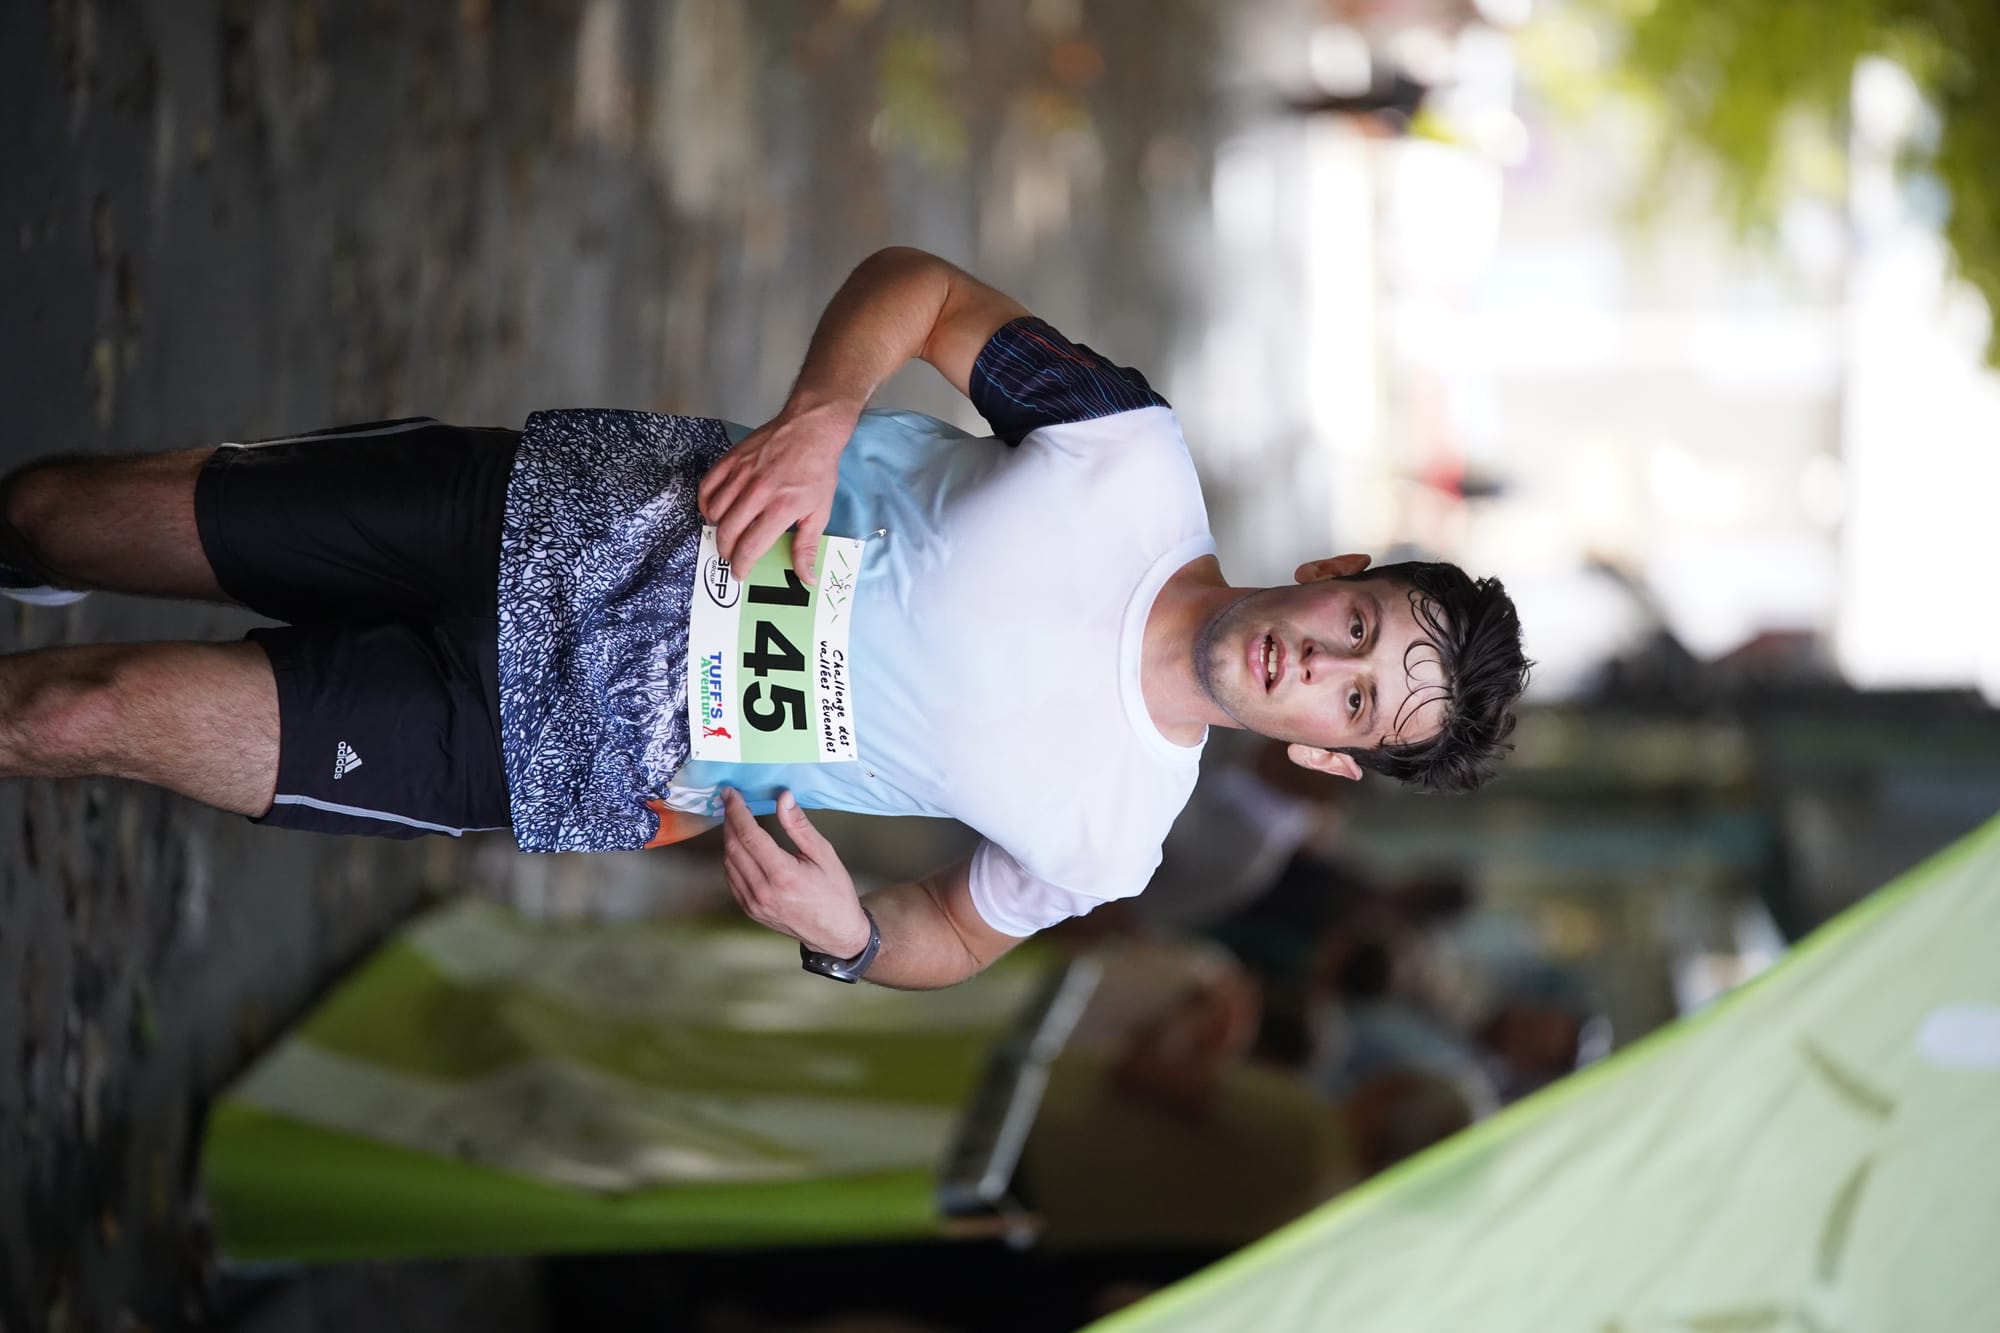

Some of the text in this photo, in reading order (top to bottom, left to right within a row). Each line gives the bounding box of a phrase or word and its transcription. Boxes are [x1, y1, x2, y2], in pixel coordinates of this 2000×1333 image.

[709, 559, 718, 585] GROUP
[709, 651, 723, 719] TUFF'S
[743, 568, 811, 733] 145
[700, 656, 713, 725] Aventure
[820, 640, 836, 753] vallées cévenoles
[831, 649, 850, 746] Challenge des
[333, 741, 347, 780] adidas
